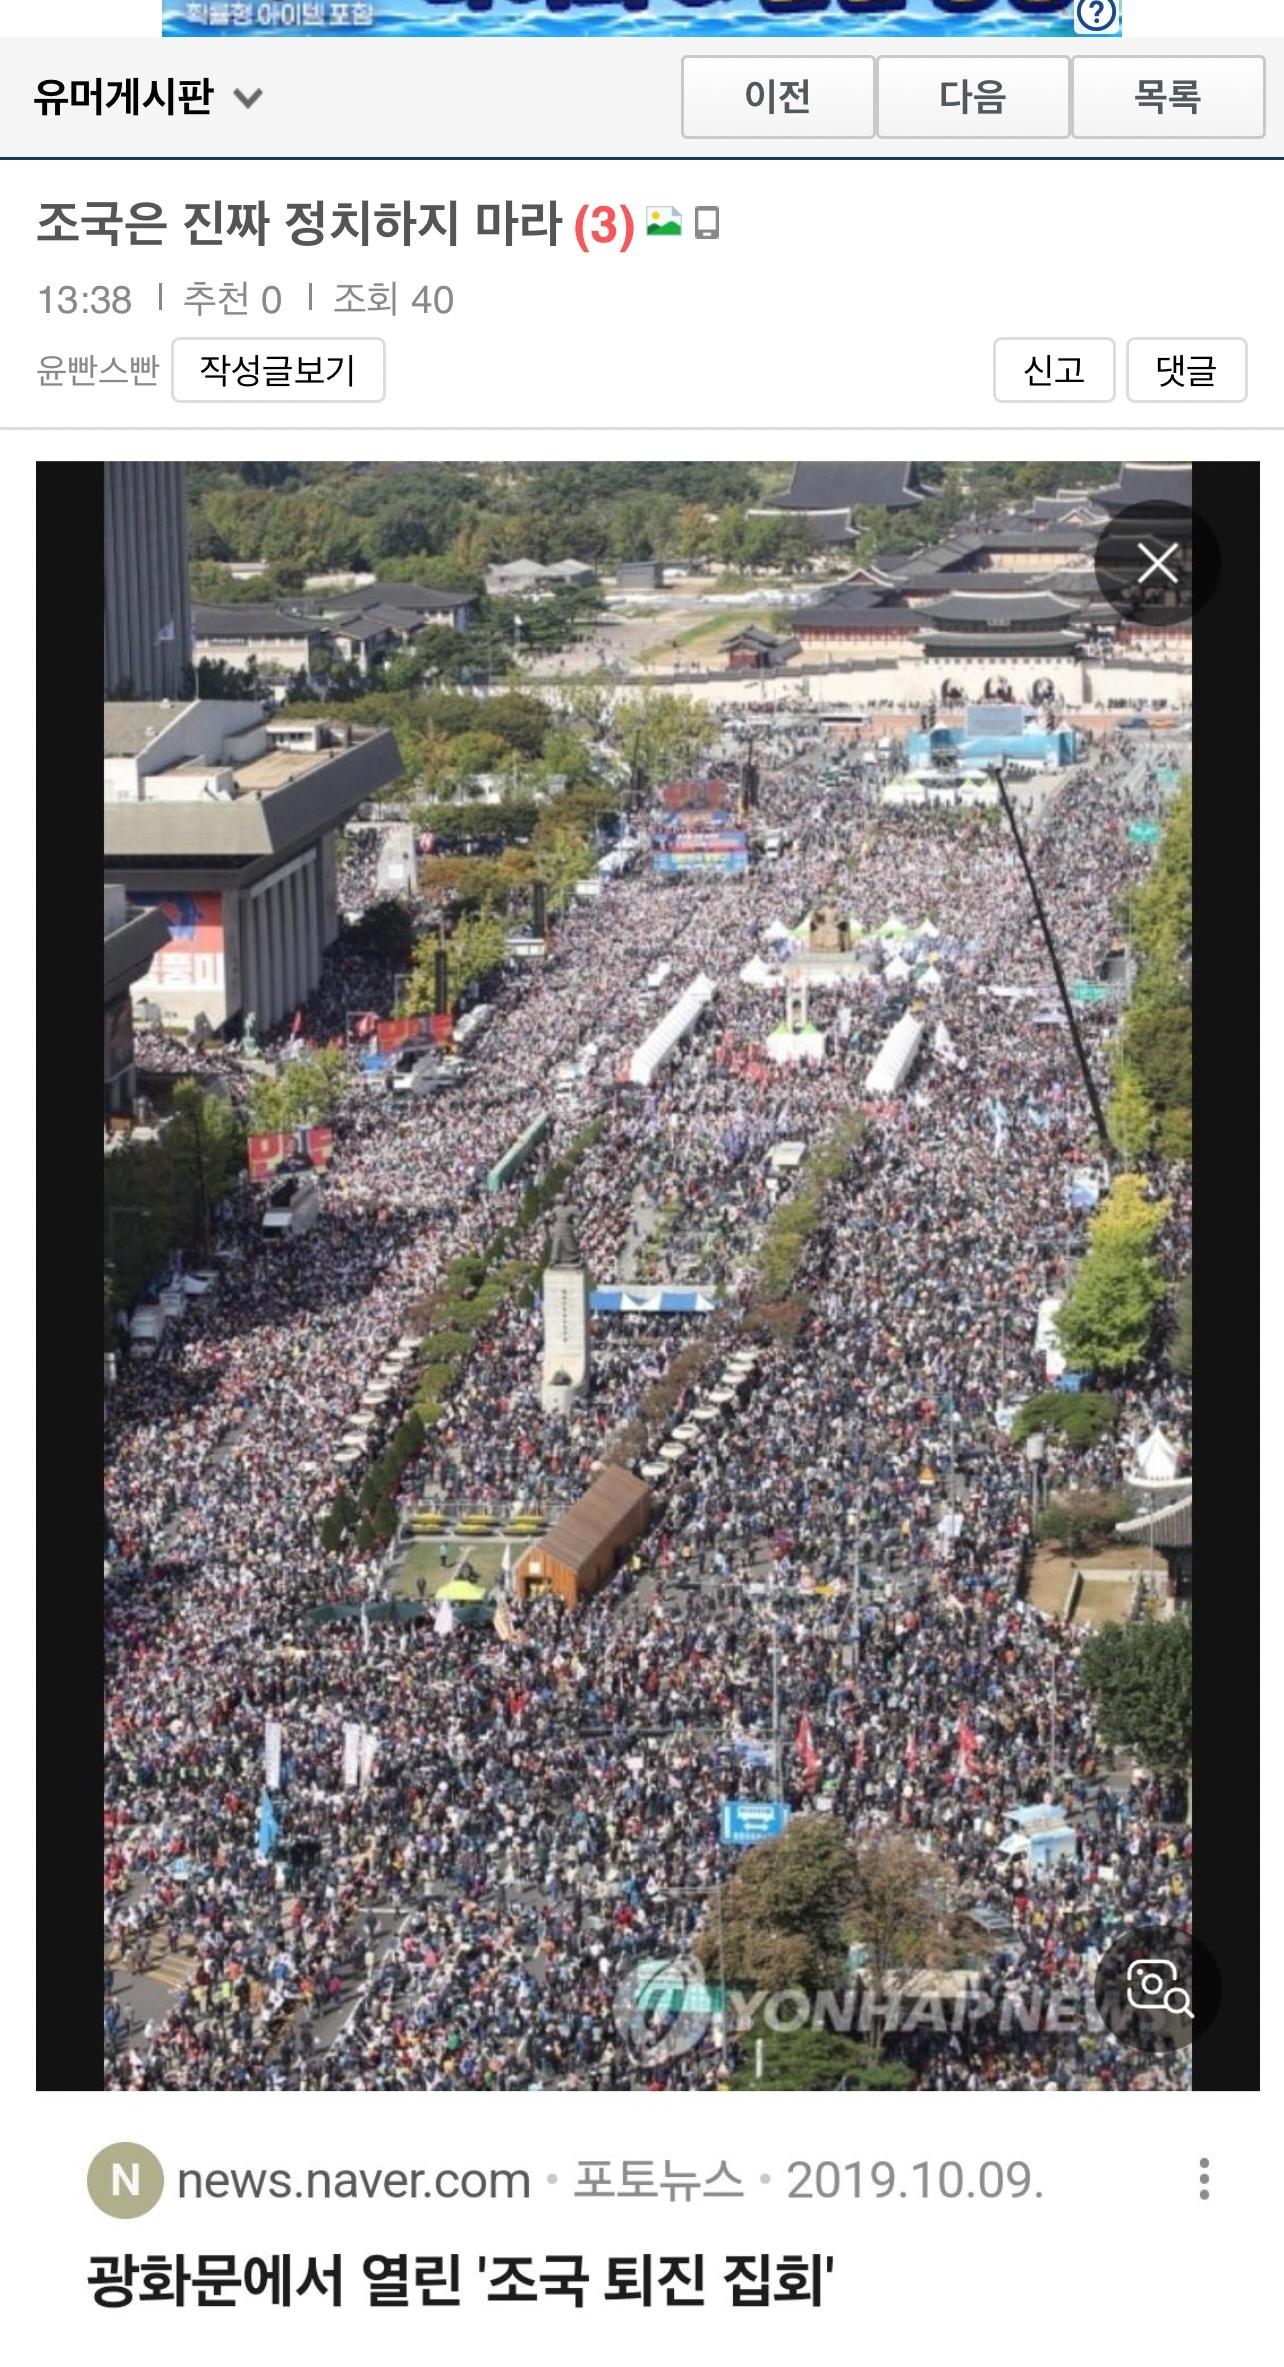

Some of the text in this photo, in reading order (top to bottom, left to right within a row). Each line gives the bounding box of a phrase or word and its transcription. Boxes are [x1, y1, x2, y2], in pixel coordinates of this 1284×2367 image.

[257, 3, 325, 27] 아이템
[329, 3, 375, 26] 포함
[34, 77, 214, 117] 유머게시판
[745, 78, 810, 115] 이전
[940, 78, 1007, 115] 다음
[1134, 79, 1202, 115] 목록
[37, 200, 635, 253] 조국은 진짜 정치하지 마라 (3)
[39, 281, 454, 317] 13:38 추천 0 조회 40
[37, 354, 160, 387] 윤빤스빤
[200, 354, 355, 388] 작성글보기
[1024, 354, 1085, 387] 신고
[1156, 354, 1217, 388] 댓글
[178, 2159, 1043, 2203] news.naver.com 포토뉴스 2019.10.09.
[87, 2253, 834, 2309] 광화문에서 열린 '조국 퇴진 집회'
